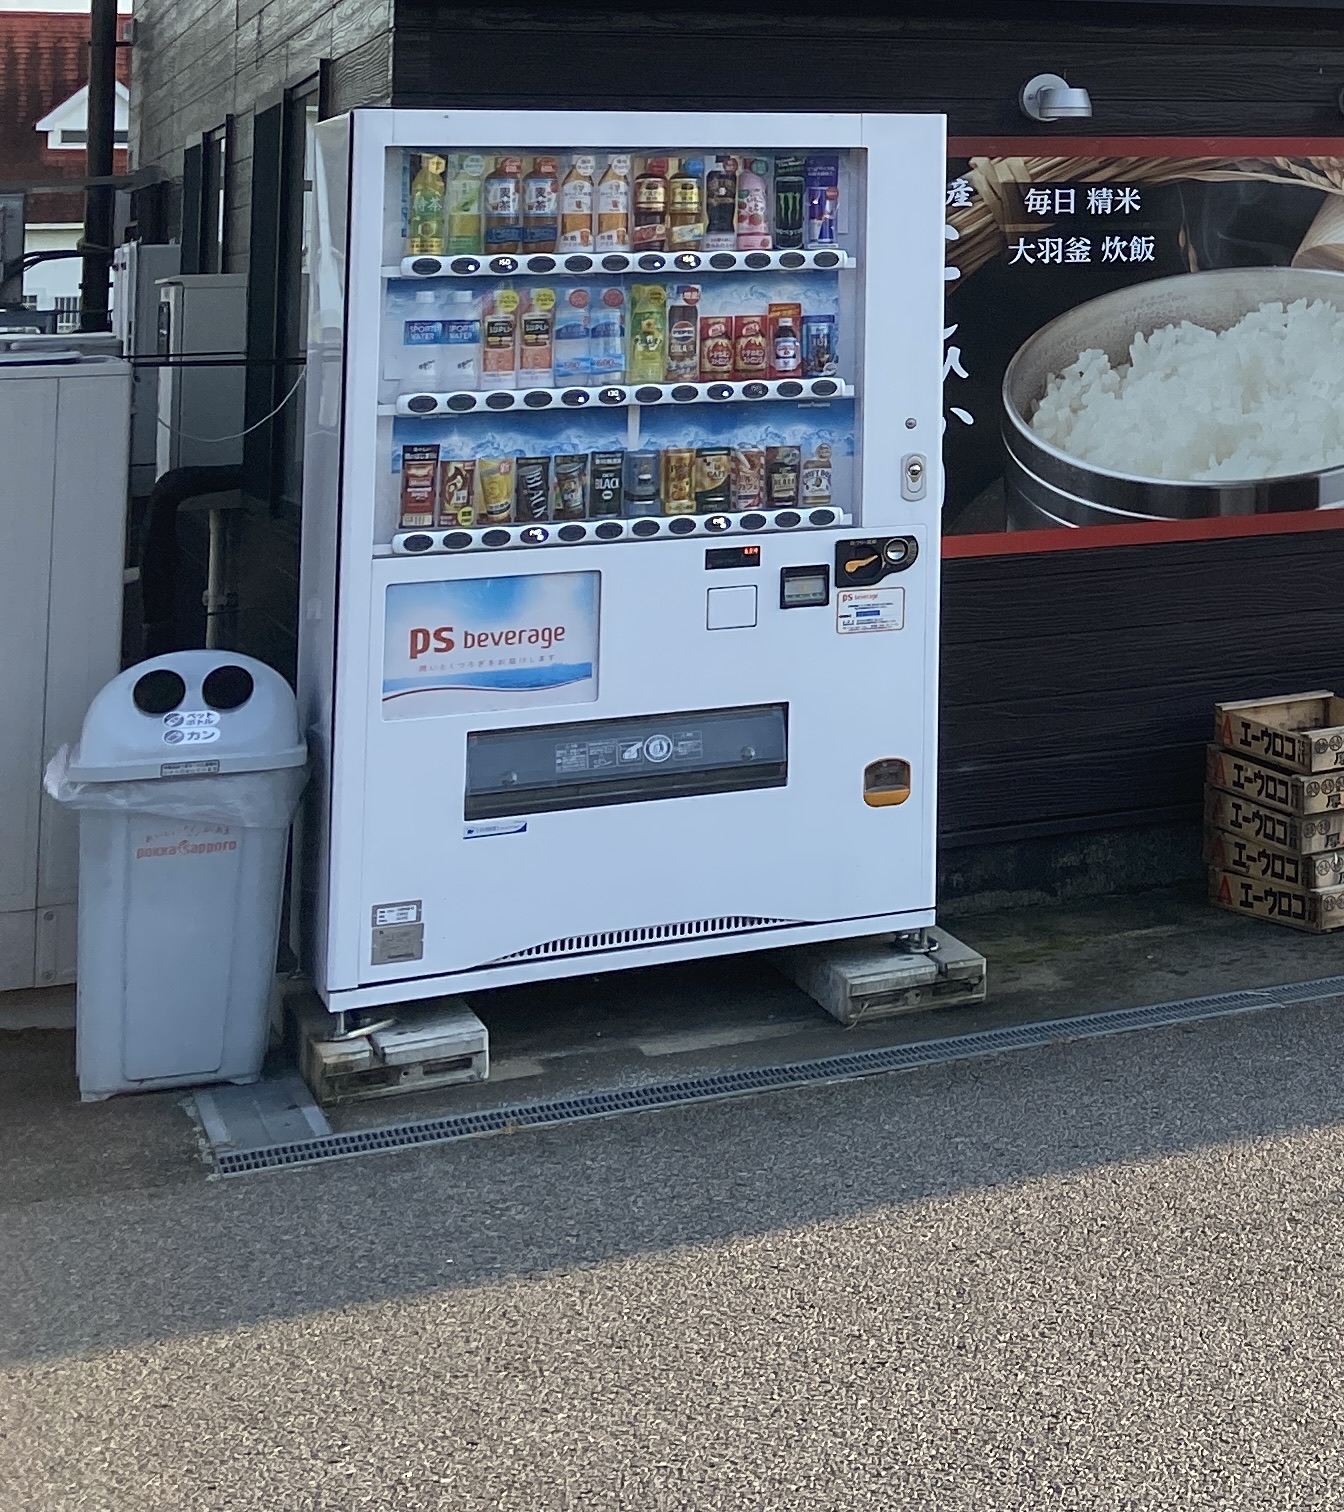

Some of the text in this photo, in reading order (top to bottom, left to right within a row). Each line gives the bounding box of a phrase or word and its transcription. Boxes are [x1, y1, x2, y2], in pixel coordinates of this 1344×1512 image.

[946, 178, 974, 207] 産
[1024, 187, 1141, 215] 毎日 精米
[1007, 235, 1156, 265] 大羽釜 炊飯
[525, 470, 547, 519] BLACK
[463, 626, 565, 649] beverage
[186, 730, 216, 741] カン
